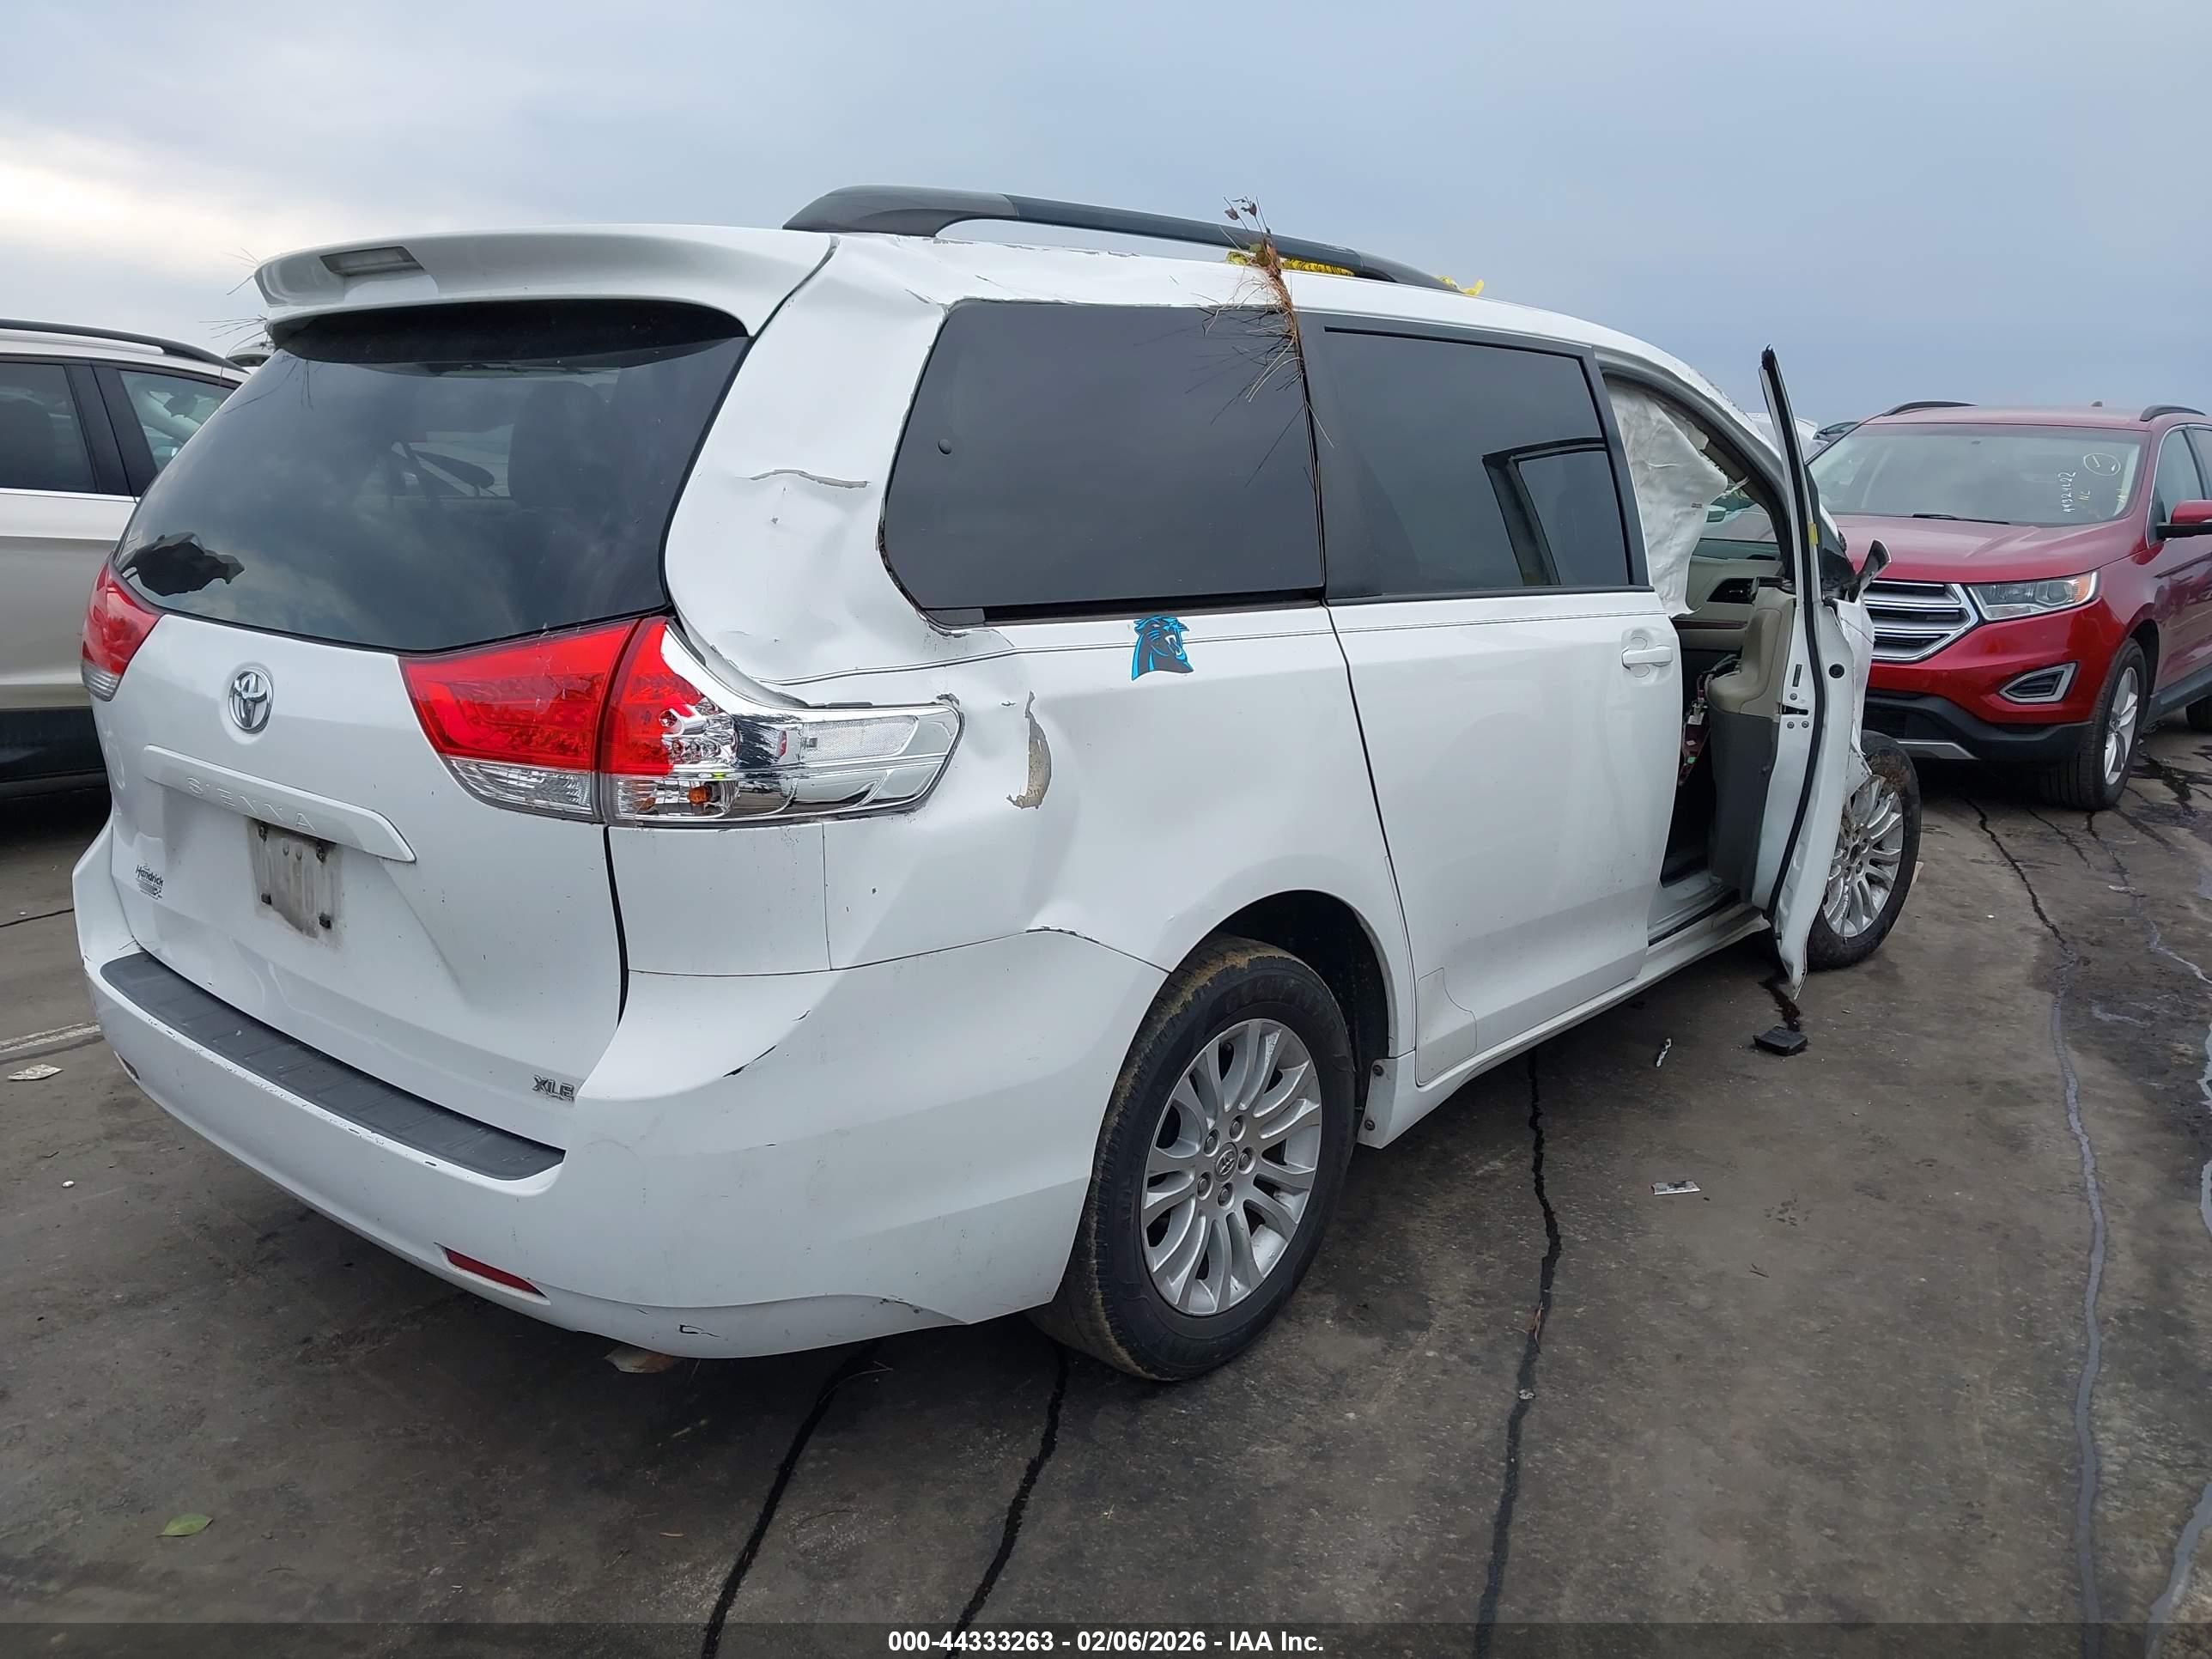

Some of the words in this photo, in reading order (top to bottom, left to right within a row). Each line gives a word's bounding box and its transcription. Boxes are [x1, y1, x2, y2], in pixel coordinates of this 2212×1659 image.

[186, 776, 316, 832] SENNA
[136, 864, 163, 886] Hendrick
[532, 1074, 574, 1102] XLE
